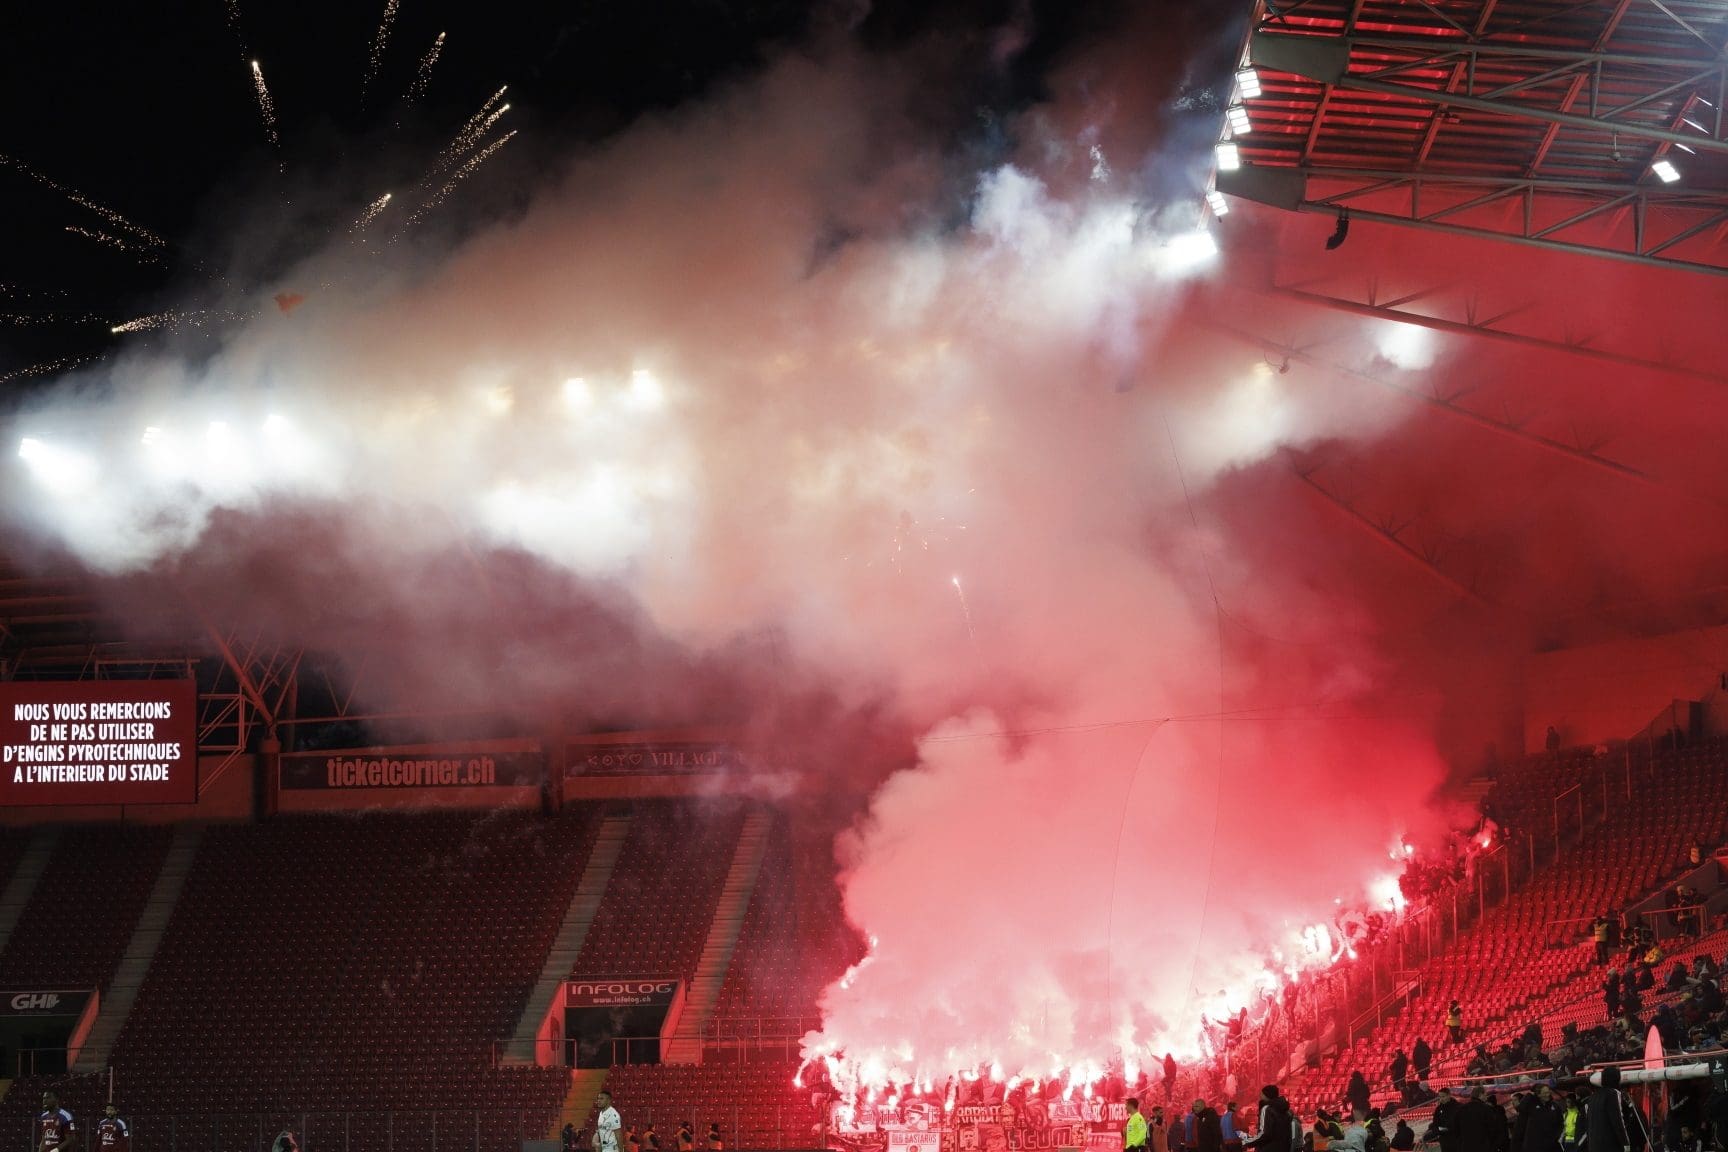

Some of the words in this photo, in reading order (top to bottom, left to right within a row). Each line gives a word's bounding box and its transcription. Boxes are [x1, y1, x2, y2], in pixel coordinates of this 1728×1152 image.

[14, 704, 50, 721] NOUS
[53, 703, 87, 720] VOUS
[90, 702, 171, 720] REMERCIONS
[30, 725, 47, 741] DE
[51, 725, 67, 741] NE
[71, 724, 95, 741] PAS
[98, 723, 154, 740] UTILISER
[3, 745, 65, 762] D'ENGINS
[68, 743, 181, 762] PYROTECHNIQUES
[13, 766, 23, 783] A
[26, 764, 105, 783] L'INTERIEUR
[108, 764, 126, 781] DU
[130, 764, 169, 781] STADE
[327, 756, 495, 786] ticketcorner.ch
[572, 983, 672, 995] INFOLOG
